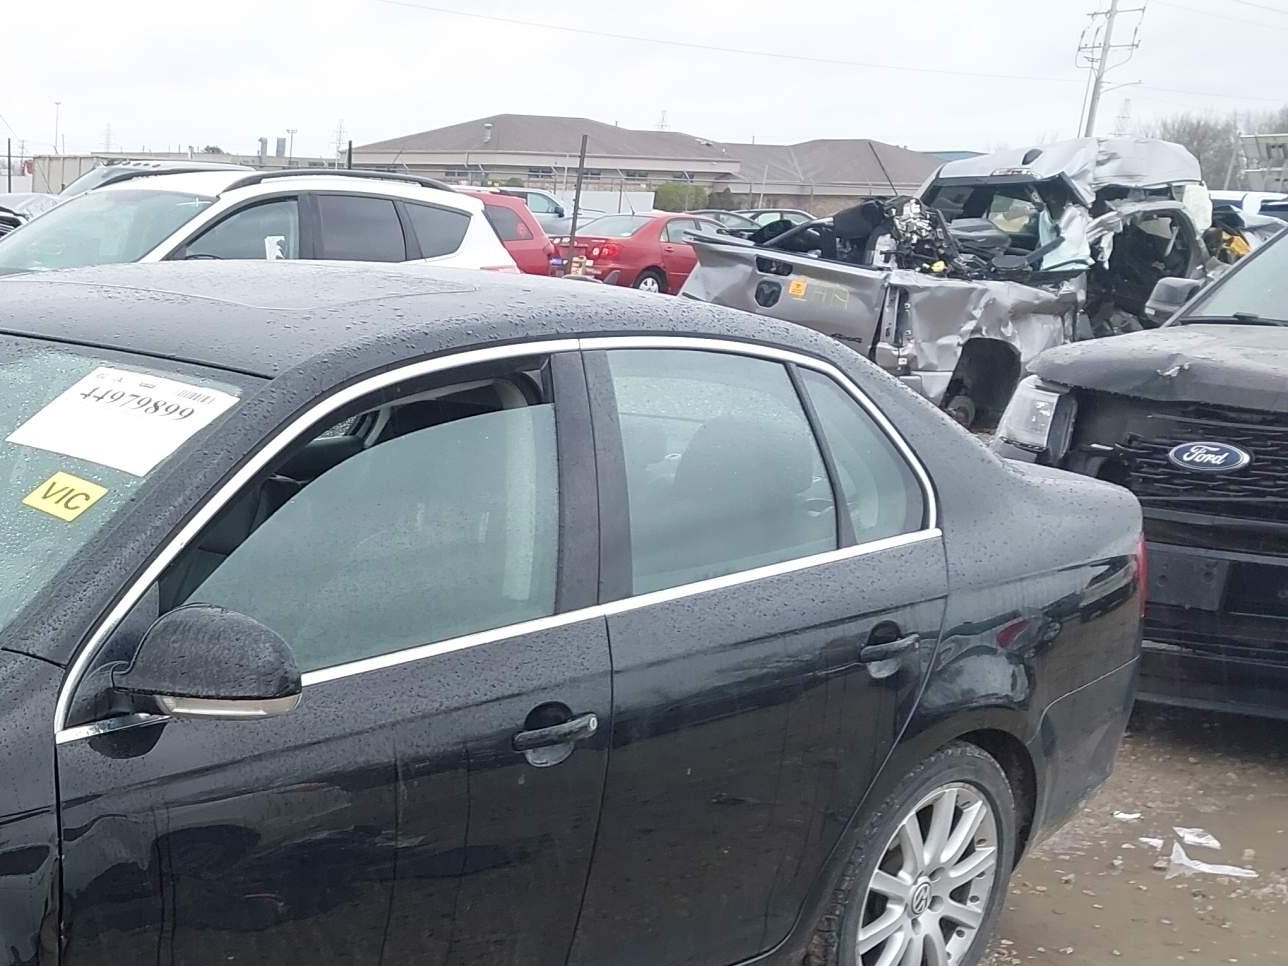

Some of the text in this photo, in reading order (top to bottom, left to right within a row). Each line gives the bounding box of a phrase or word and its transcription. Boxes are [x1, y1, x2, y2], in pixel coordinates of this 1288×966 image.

[79, 386, 195, 421] 44979899
[1182, 445, 1230, 465] Ford
[40, 481, 91, 511] VIC
